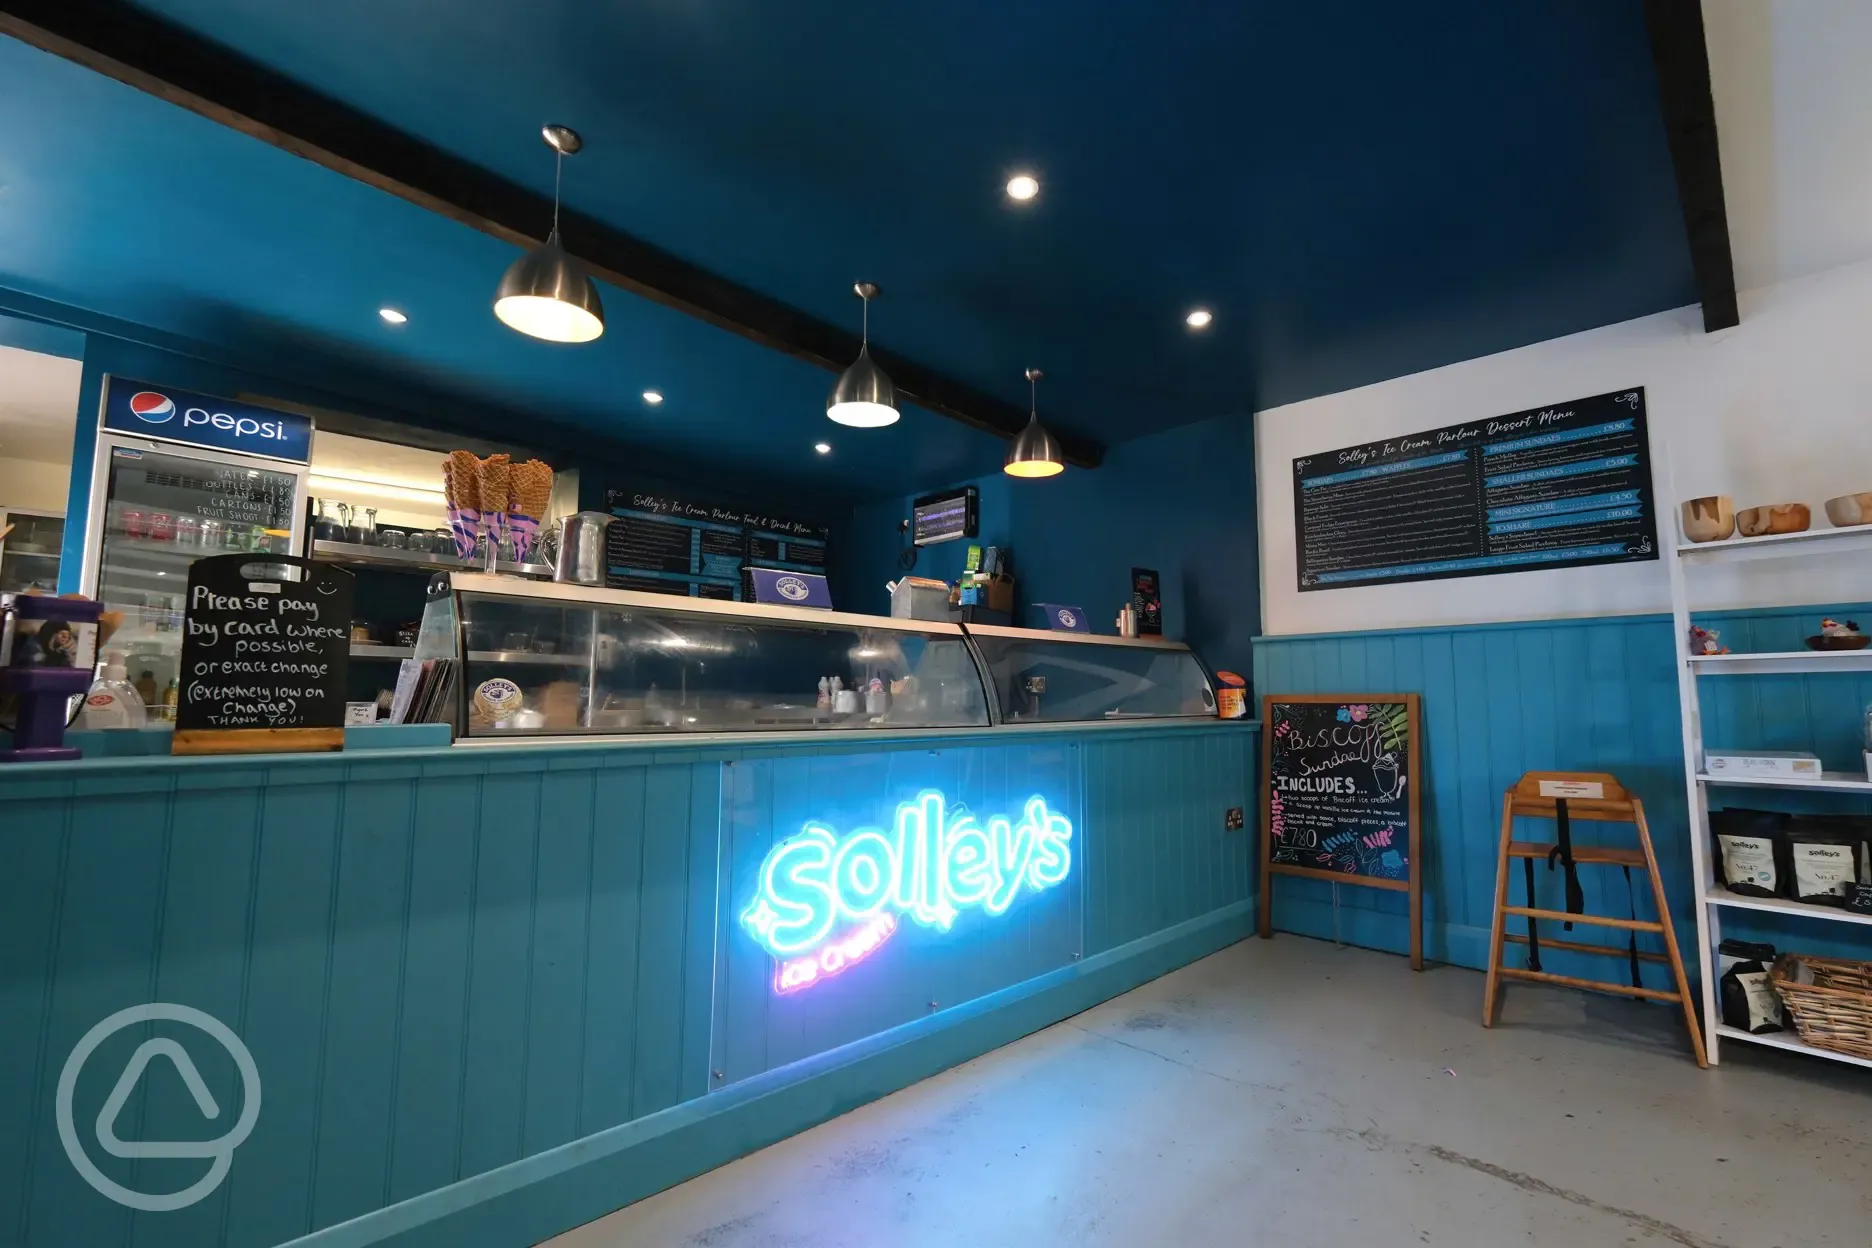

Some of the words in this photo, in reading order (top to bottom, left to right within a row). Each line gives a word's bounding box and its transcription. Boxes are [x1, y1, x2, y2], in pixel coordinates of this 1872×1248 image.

[184, 408, 283, 440] pepsi
[1339, 446, 1376, 465] Solley's
[1382, 442, 1396, 457] Ice
[1400, 439, 1432, 453] Cream
[1437, 427, 1481, 446] Parlour
[1486, 415, 1533, 436] Dessert
[1538, 409, 1575, 426] Menu
[1490, 442, 1524, 453] PREMIUM
[1524, 434, 1561, 447] SUNDAES
[1491, 474, 1526, 485] SMALLER
[1526, 468, 1563, 479] SUNDAES
[197, 505, 224, 518] FRUIT
[228, 510, 259, 521] SHOOT
[211, 497, 261, 512] CARTONS
[633, 494, 667, 514] Solley's
[671, 501, 683, 512] Ice
[685, 504, 709, 517] Cream
[712, 508, 740, 522] Parlour
[743, 513, 758, 526] Food
[770, 519, 790, 530] Drink
[793, 523, 812, 534] Menu
[1512, 502, 1556, 514] SIGNATURE
[192, 585, 269, 611] Please
[278, 598, 319, 621] pay
[187, 617, 218, 647] by
[224, 618, 280, 636] card
[287, 624, 347, 639] where
[235, 639, 323, 658] possible,
[194, 661, 218, 676] or
[221, 660, 268, 675] exact
[271, 660, 328, 679] change
[187, 680, 272, 704] (extremely
[275, 685, 301, 698] low
[305, 686, 325, 699] on
[208, 715, 261, 726] THANK
[268, 715, 304, 726] YOU!
[1299, 751, 1363, 777] Sundae
[1731, 840, 1759, 850] solley's
[1808, 850, 1840, 858] solley's
